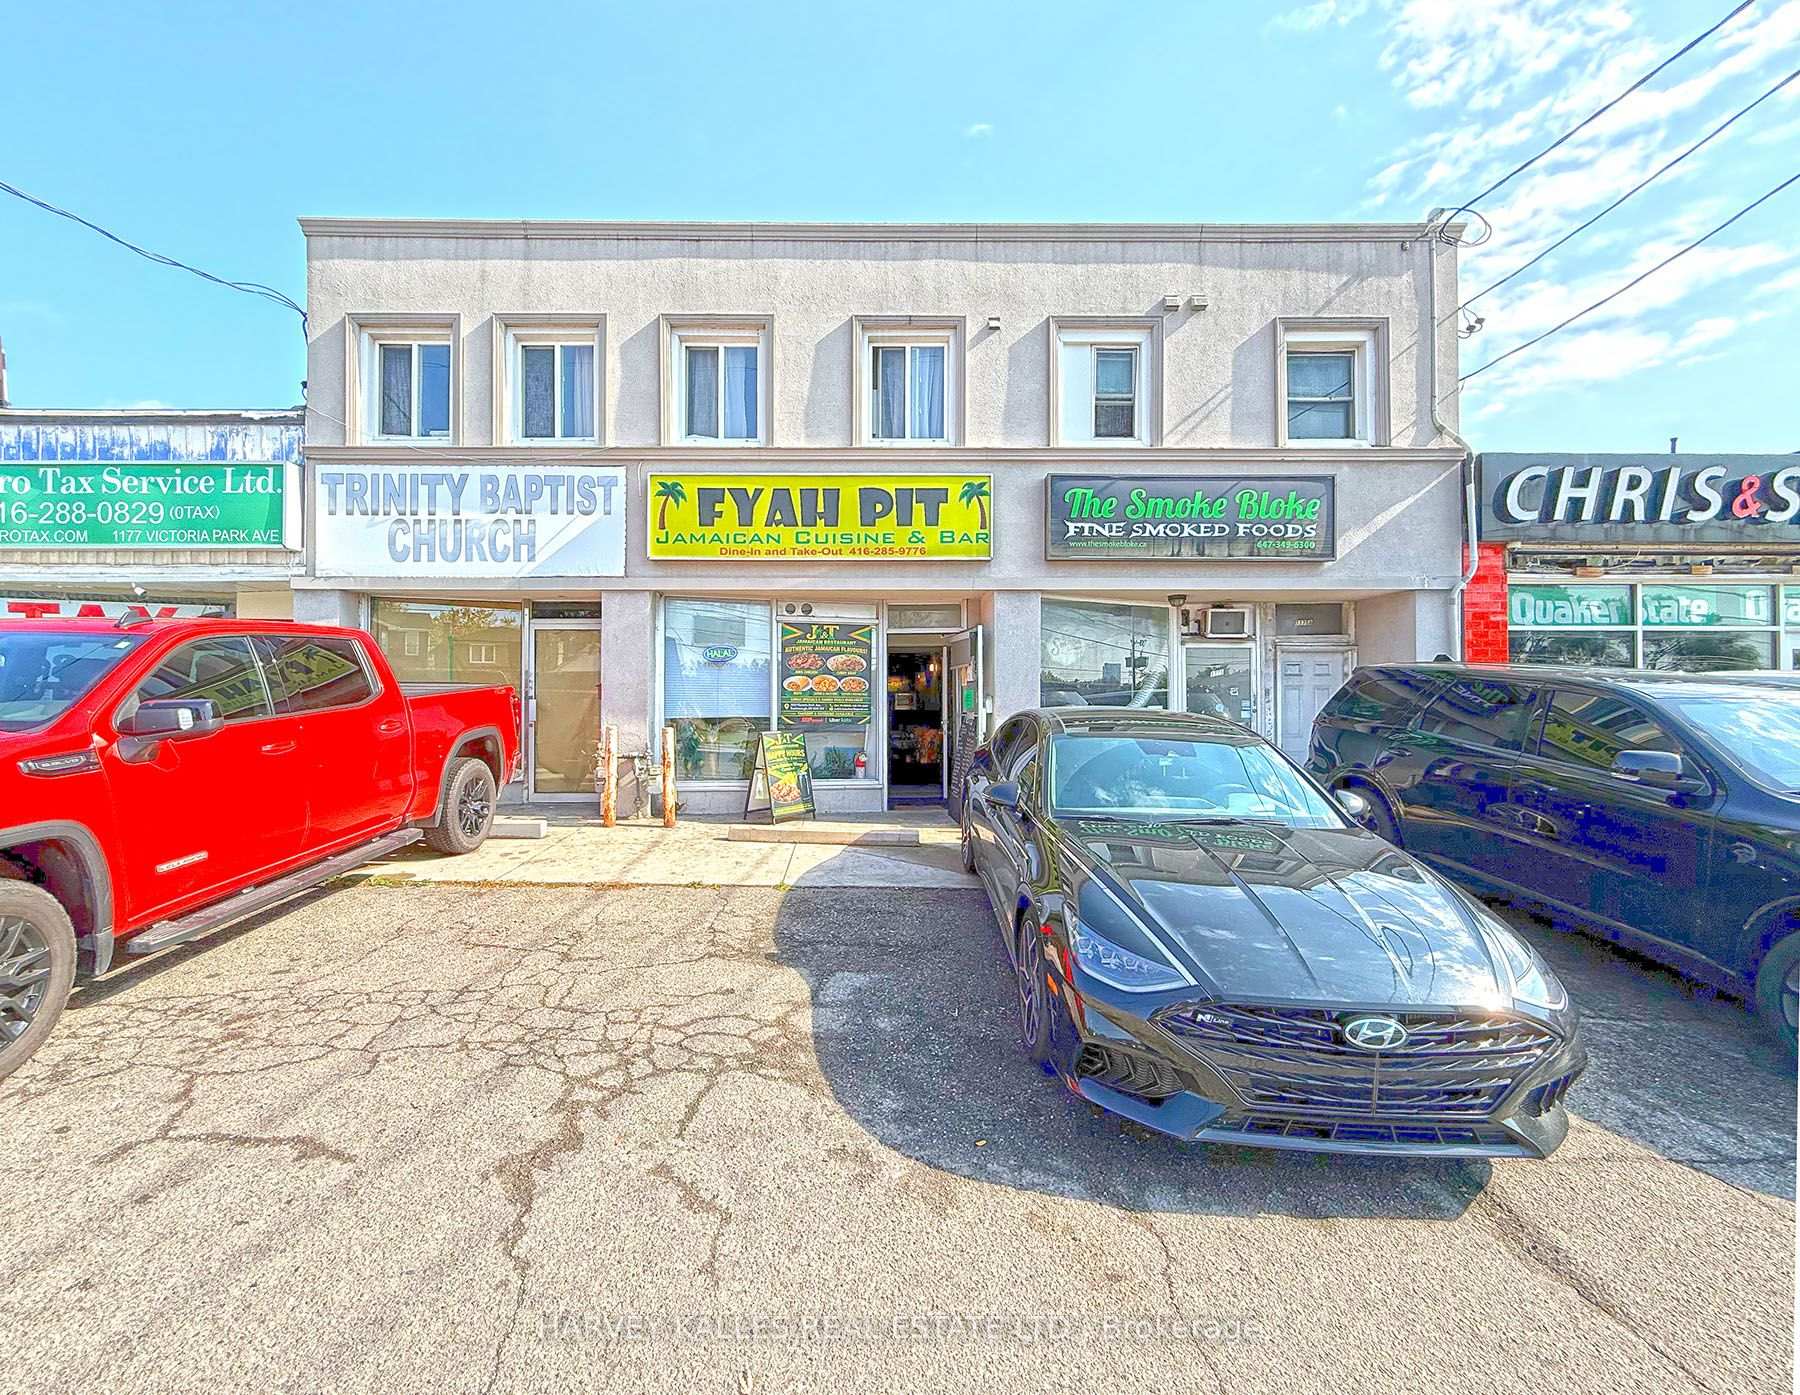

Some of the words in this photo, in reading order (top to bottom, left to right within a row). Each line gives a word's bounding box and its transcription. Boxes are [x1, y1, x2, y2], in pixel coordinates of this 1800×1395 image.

[39, 467, 97, 495] Tax
[101, 467, 215, 495] Service
[223, 467, 282, 495] Ltd.
[321, 473, 469, 516] TRINITY
[480, 474, 618, 516] BAPTIST
[697, 487, 841, 527] FYAH
[858, 487, 949, 527] PIT
[1064, 488, 1118, 518] The
[1126, 488, 1227, 520] Smoke
[1235, 489, 1321, 520] Bloke
[112, 530, 141, 542] 1177
[146, 530, 210, 542] VICTORIA
[213, 530, 250, 542] PARK
[387, 518, 536, 562] CHURCH
[656, 530, 781, 545] JAMAICAN
[795, 530, 896, 545] CUISINE
[907, 530, 926, 544] &
[939, 531, 990, 544] BAR
[1063, 520, 1127, 540] FINE
[1129, 522, 1229, 538] SMOKED
[1235, 522, 1317, 538] FOODS
[764, 547, 788, 556] and
[792, 547, 843, 556] Take-Out
[848, 547, 927, 556] 416-285-9776
[1512, 592, 1623, 625] Quaker
[1642, 595, 1709, 624] tate
